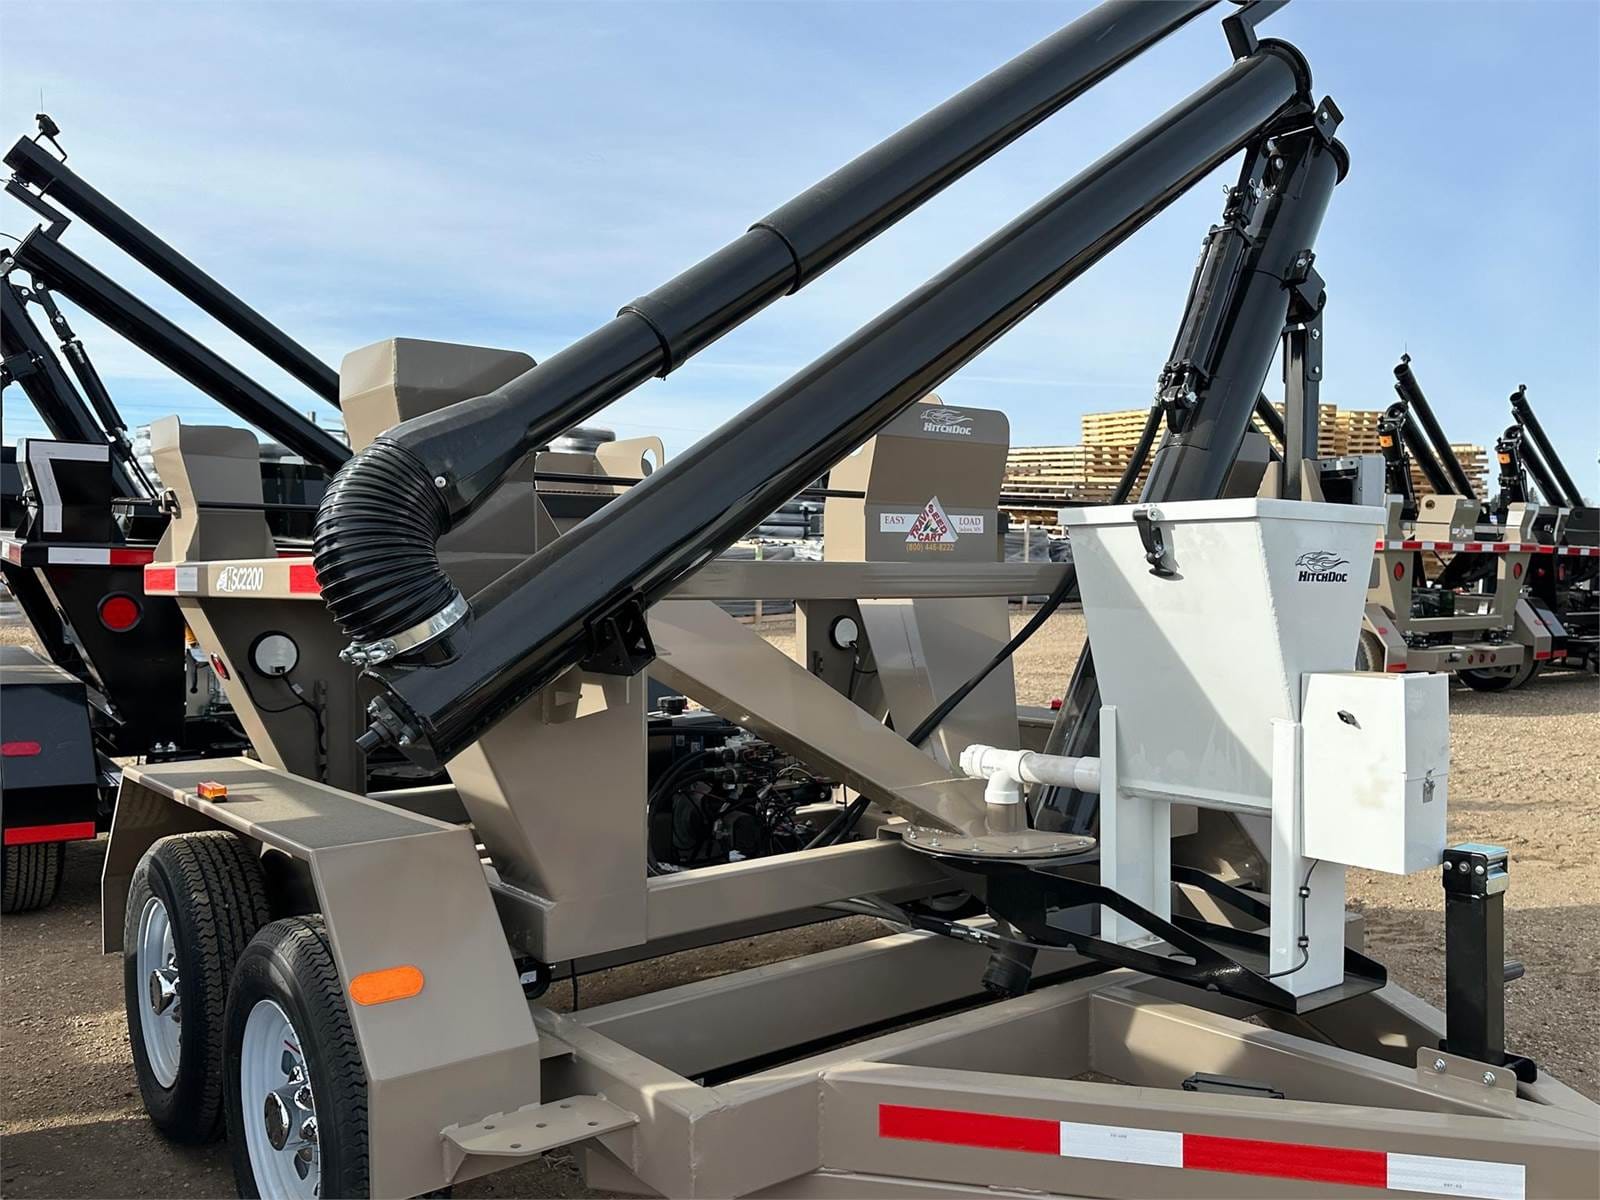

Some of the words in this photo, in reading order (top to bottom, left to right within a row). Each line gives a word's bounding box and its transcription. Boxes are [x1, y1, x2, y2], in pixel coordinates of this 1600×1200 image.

[884, 515, 906, 525] EASY
[959, 517, 982, 526] LOAD
[917, 533, 944, 541] CART
